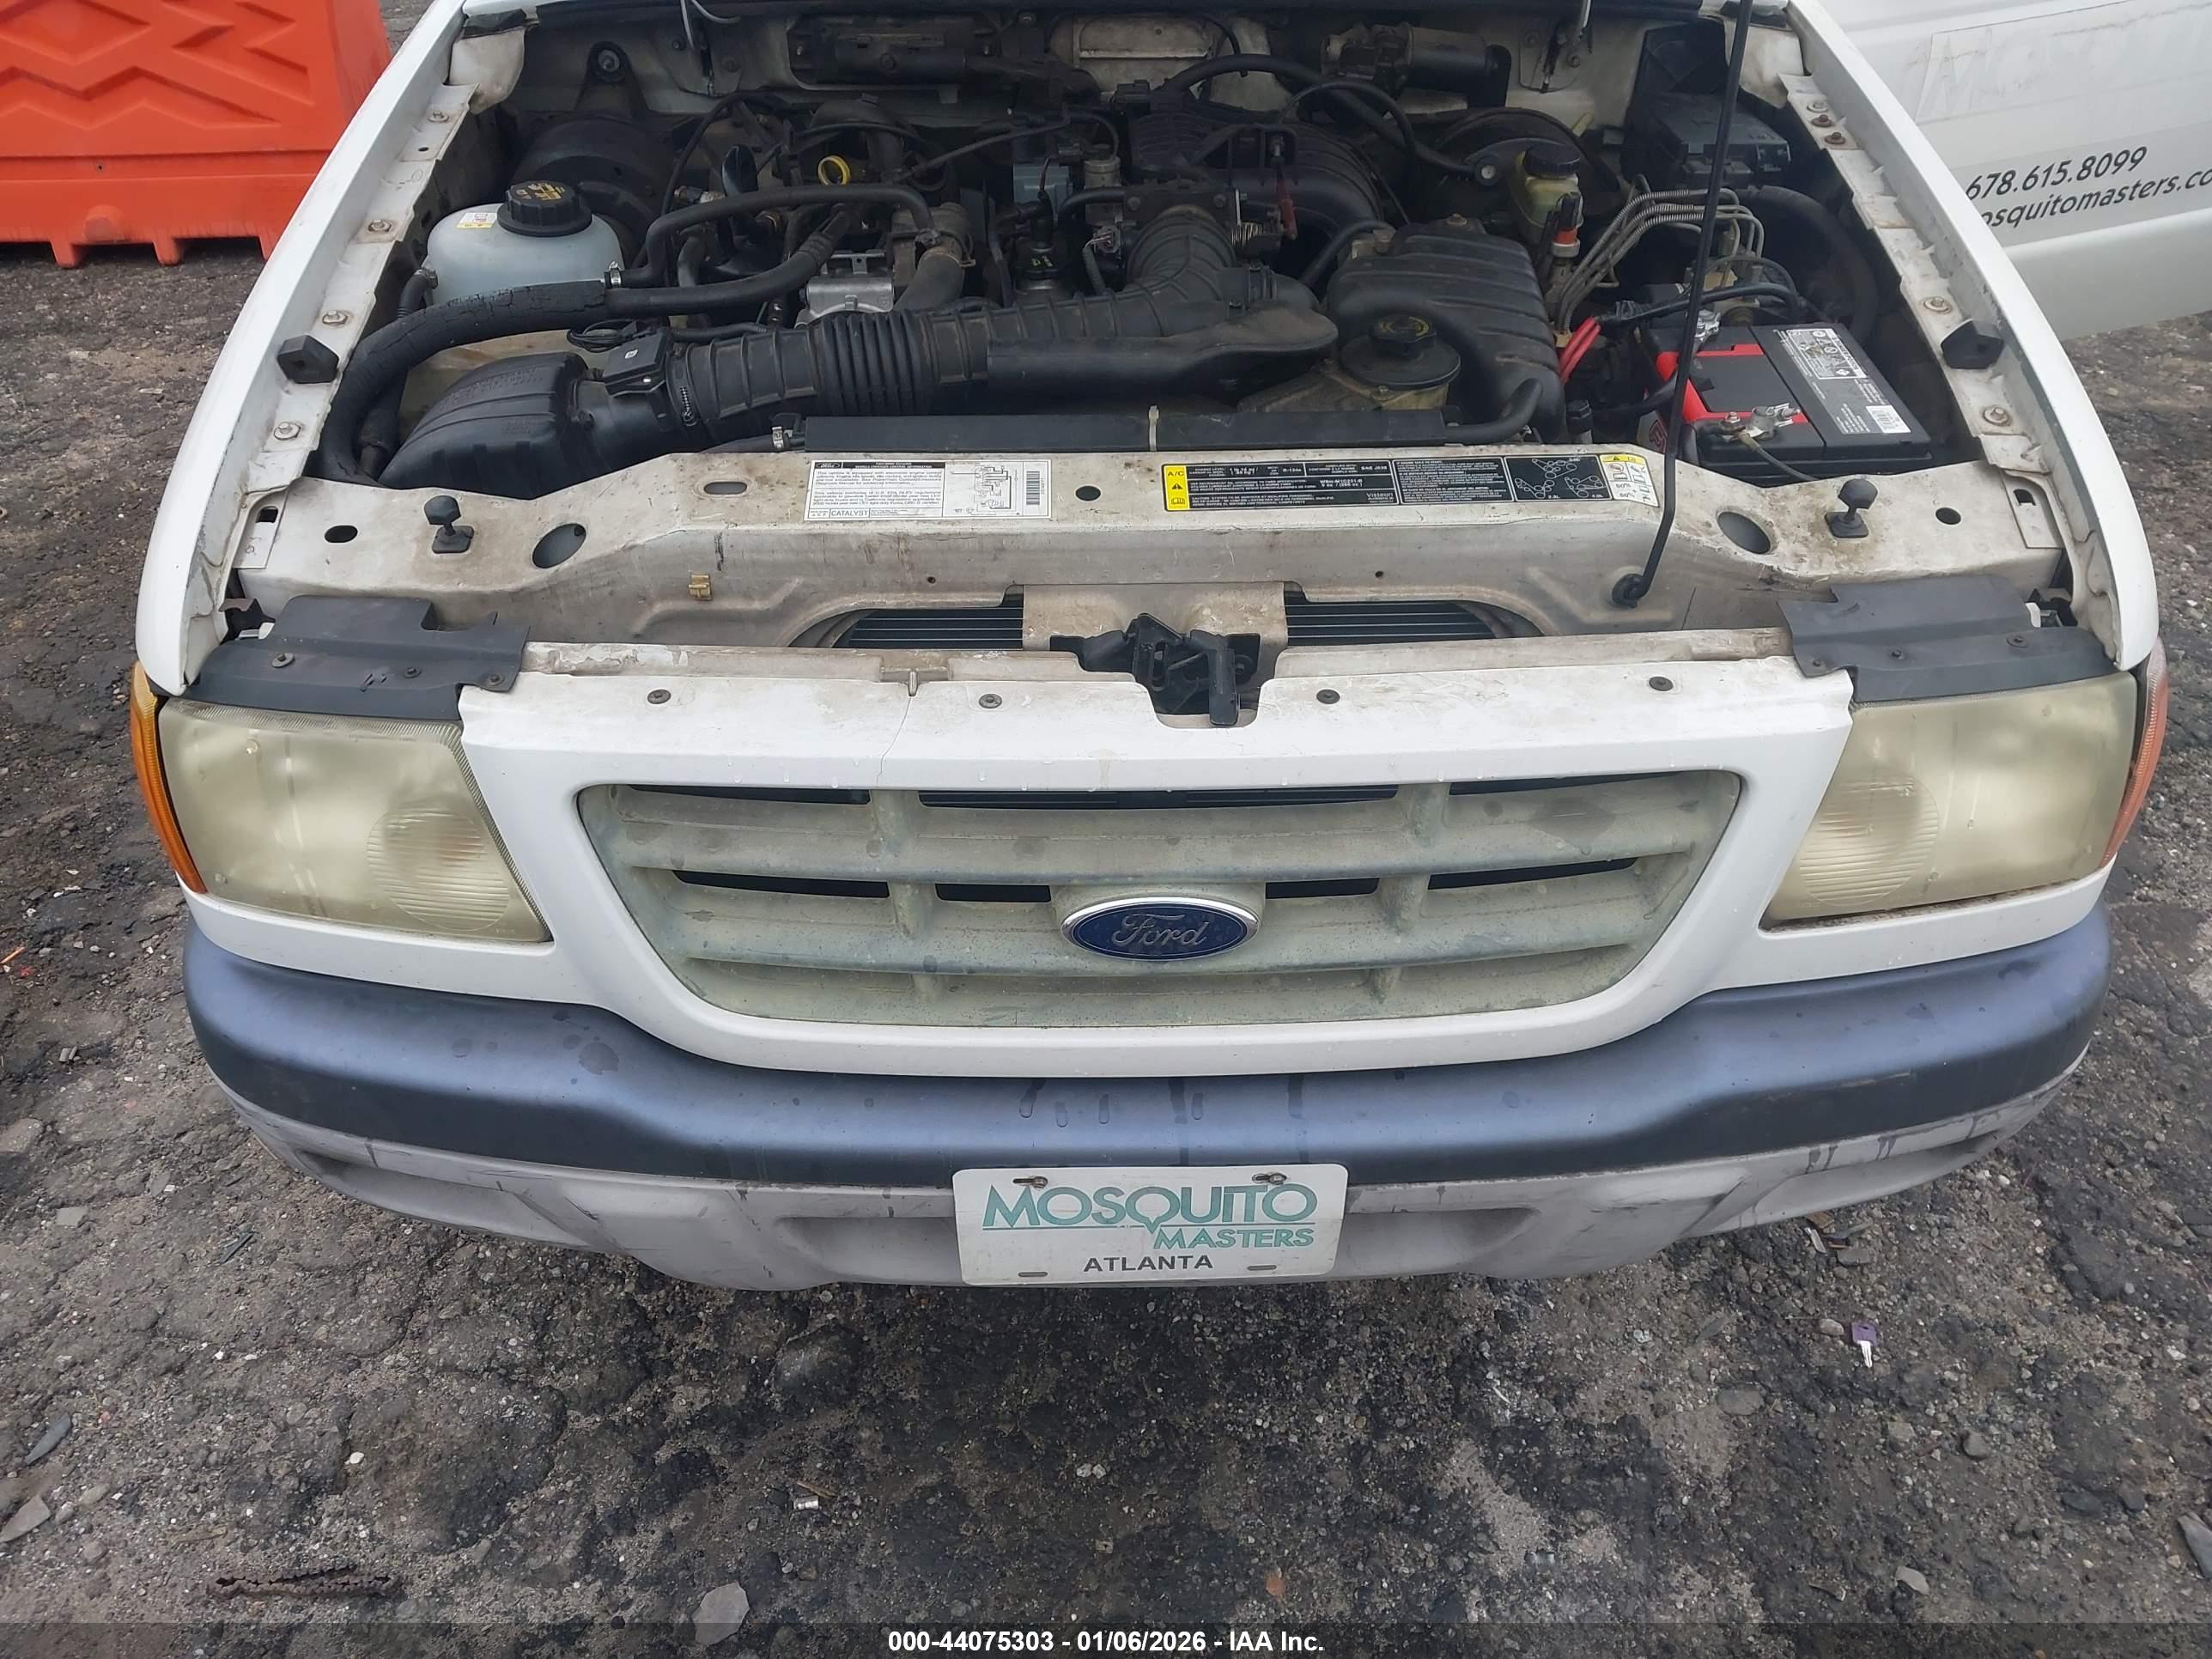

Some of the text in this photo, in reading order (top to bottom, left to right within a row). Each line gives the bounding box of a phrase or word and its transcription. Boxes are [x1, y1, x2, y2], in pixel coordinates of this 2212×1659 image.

[1966, 146, 2148, 201] 678.615.8099
[1112, 913, 1209, 945] Ford
[981, 1182, 1319, 1234] MOSQUITO
[1152, 1228, 1316, 1250] MASTERS
[1083, 1255, 1214, 1273] ATLANTA
